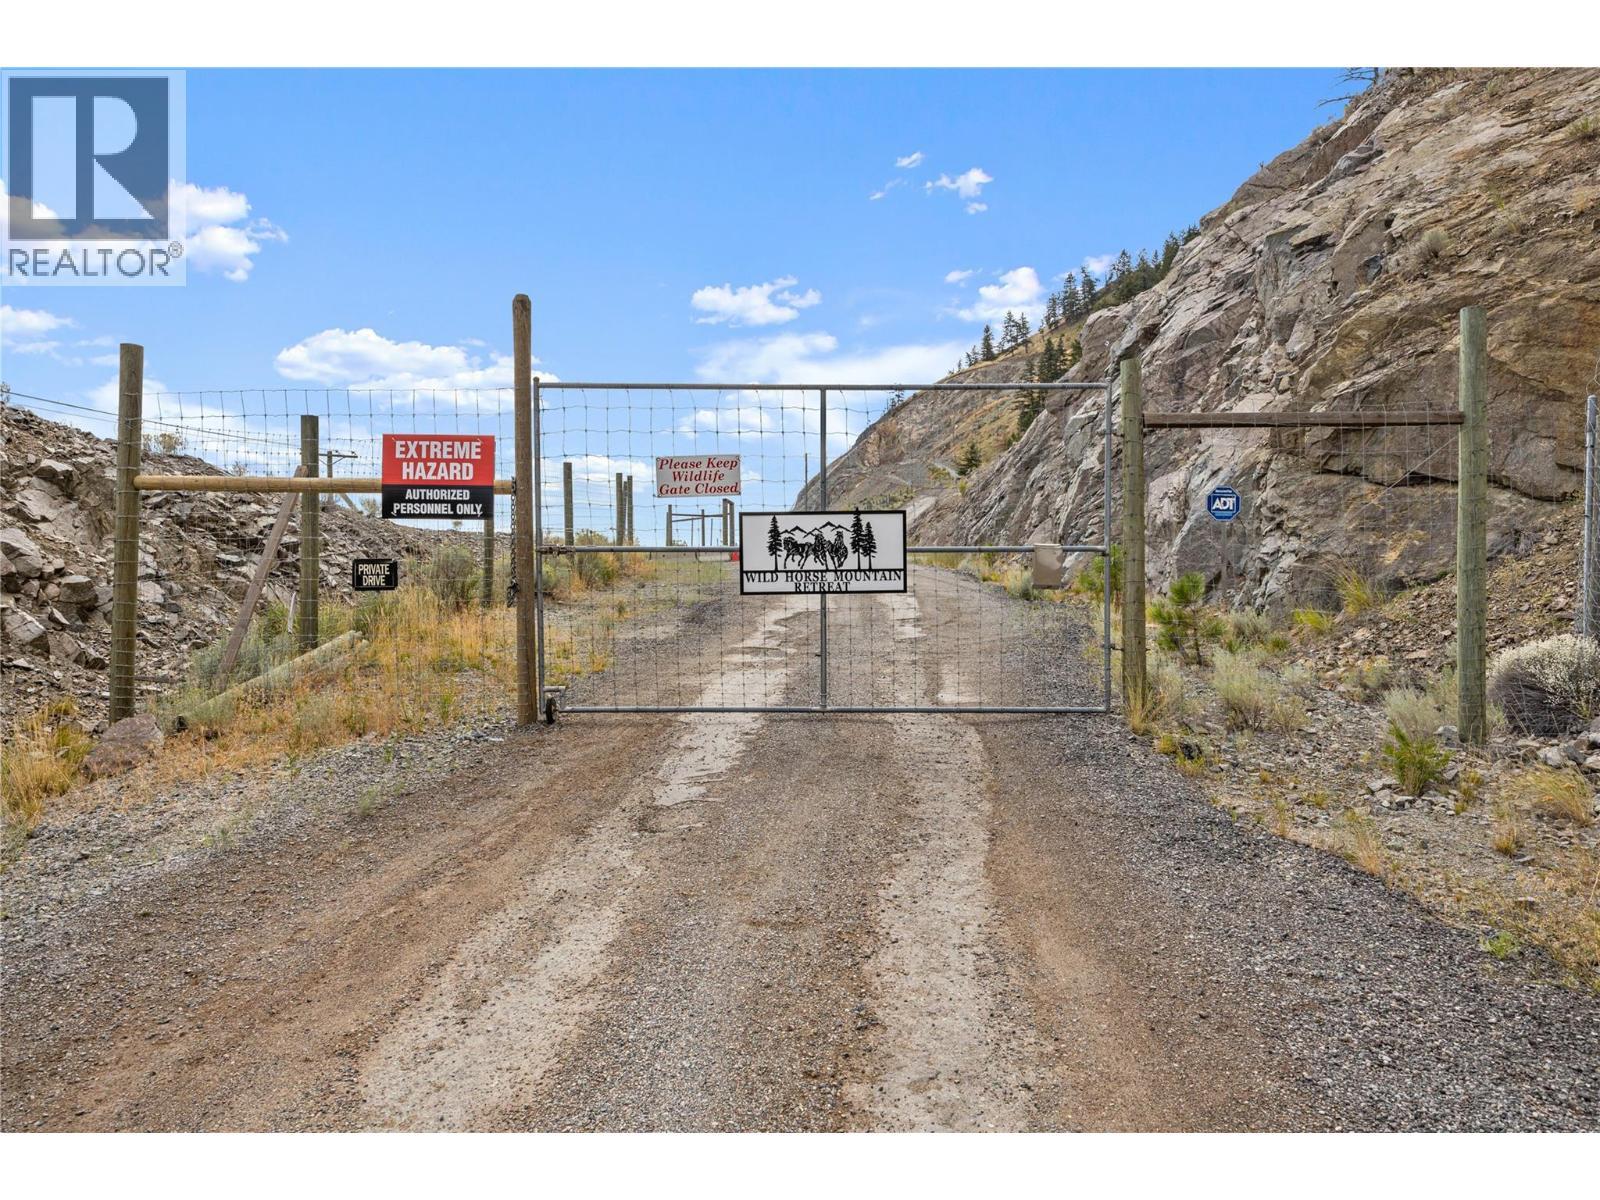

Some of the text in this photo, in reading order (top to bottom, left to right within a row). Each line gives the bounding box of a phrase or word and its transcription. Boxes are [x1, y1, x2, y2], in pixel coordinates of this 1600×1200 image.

[395, 440, 481, 459] EXTREME
[659, 457, 738, 470] Please Keep
[402, 461, 474, 480] HAZARD
[672, 470, 725, 483] Wildlife
[405, 488, 470, 501] AUTHORIZED
[659, 482, 739, 495] Gate Closed
[393, 503, 454, 515] PERSONNEL
[1212, 497, 1235, 510] ADT
[358, 563, 390, 575] PRIVATE
[362, 575, 386, 586] DRIVE
[745, 570, 902, 583] WILD HORSE MOUNTAIN
[795, 582, 850, 592] RETREAT
